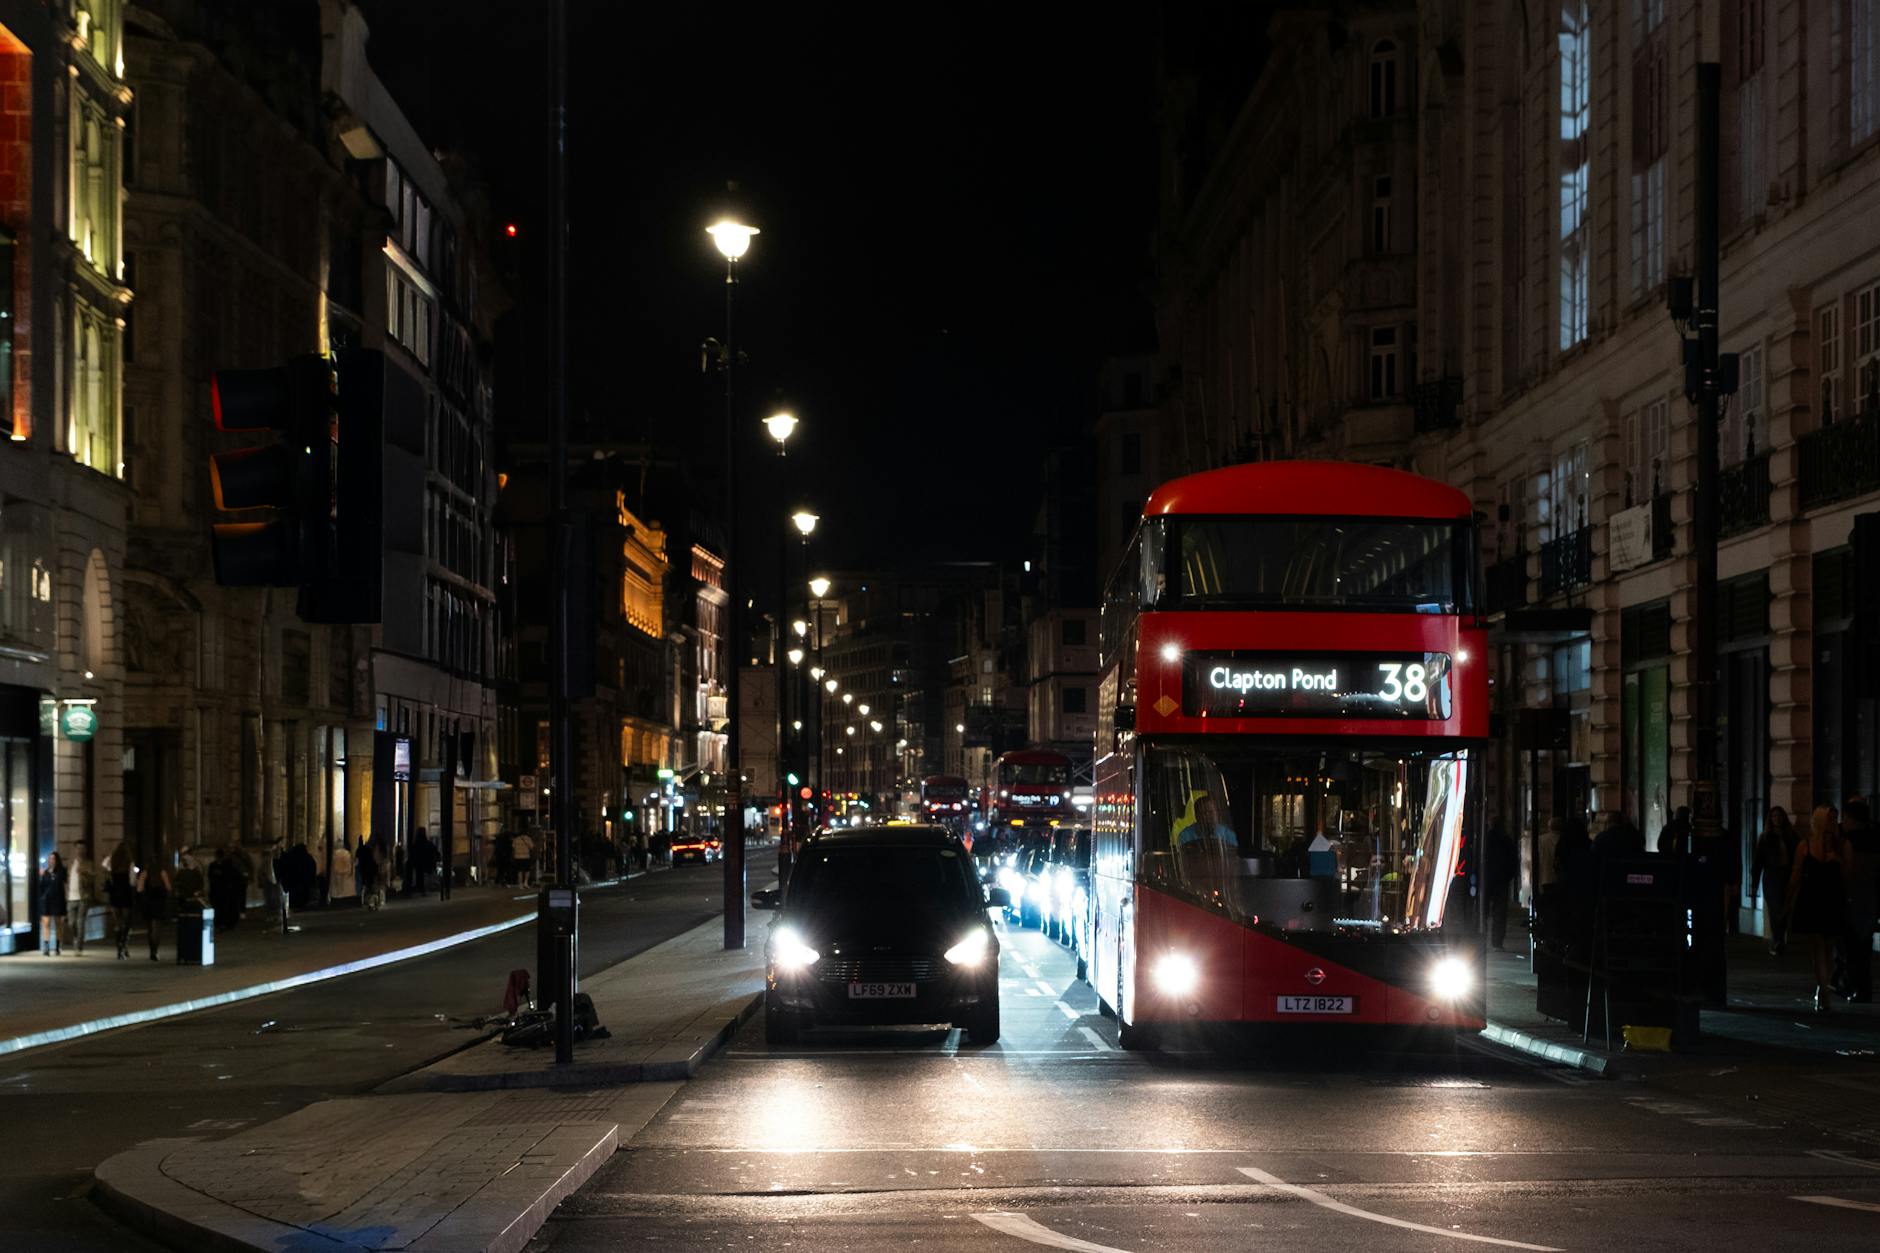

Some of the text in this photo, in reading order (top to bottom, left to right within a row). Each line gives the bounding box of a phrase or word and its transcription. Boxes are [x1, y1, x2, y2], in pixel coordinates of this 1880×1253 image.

[1209, 666, 1337, 694] Clapton Pond
[1378, 663, 1427, 703] 38
[1049, 795, 1060, 806] 19
[853, 984, 885, 996] LF69
[1284, 997, 1344, 1012] LTZ 1822
